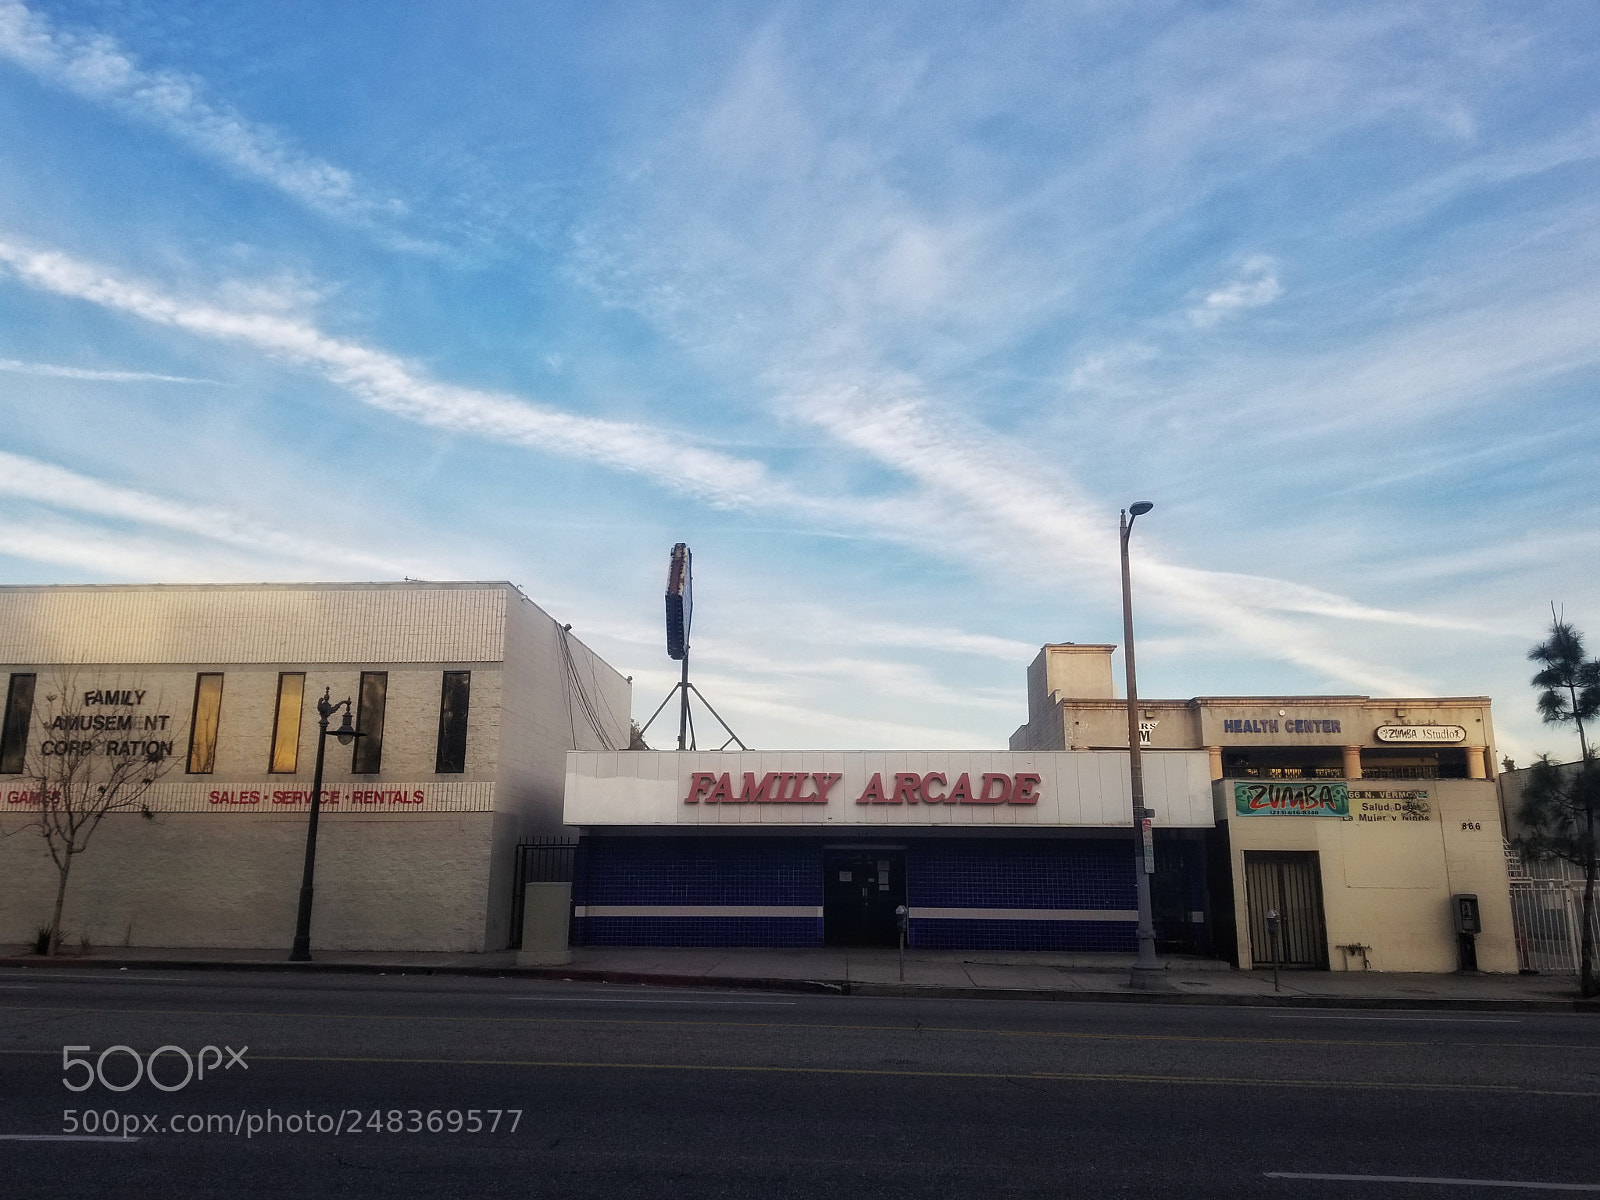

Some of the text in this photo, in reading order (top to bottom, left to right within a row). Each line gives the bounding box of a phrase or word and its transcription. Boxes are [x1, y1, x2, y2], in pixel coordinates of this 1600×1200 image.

[84, 690, 146, 706] FAMILY
[1137, 722, 1157, 730] RS
[1223, 719, 1341, 733] HEALTH CENTER
[1388, 728, 1418, 739] ZUMBA
[41, 740, 173, 756] CORPRATION
[684, 772, 1042, 804] FAMILY ARCADE
[209, 790, 424, 804] SALES SERVCE RENTALS
[1247, 784, 1336, 810] ZUMBA
[1362, 802, 1390, 811] Salud
[1462, 822, 1481, 831] 866
